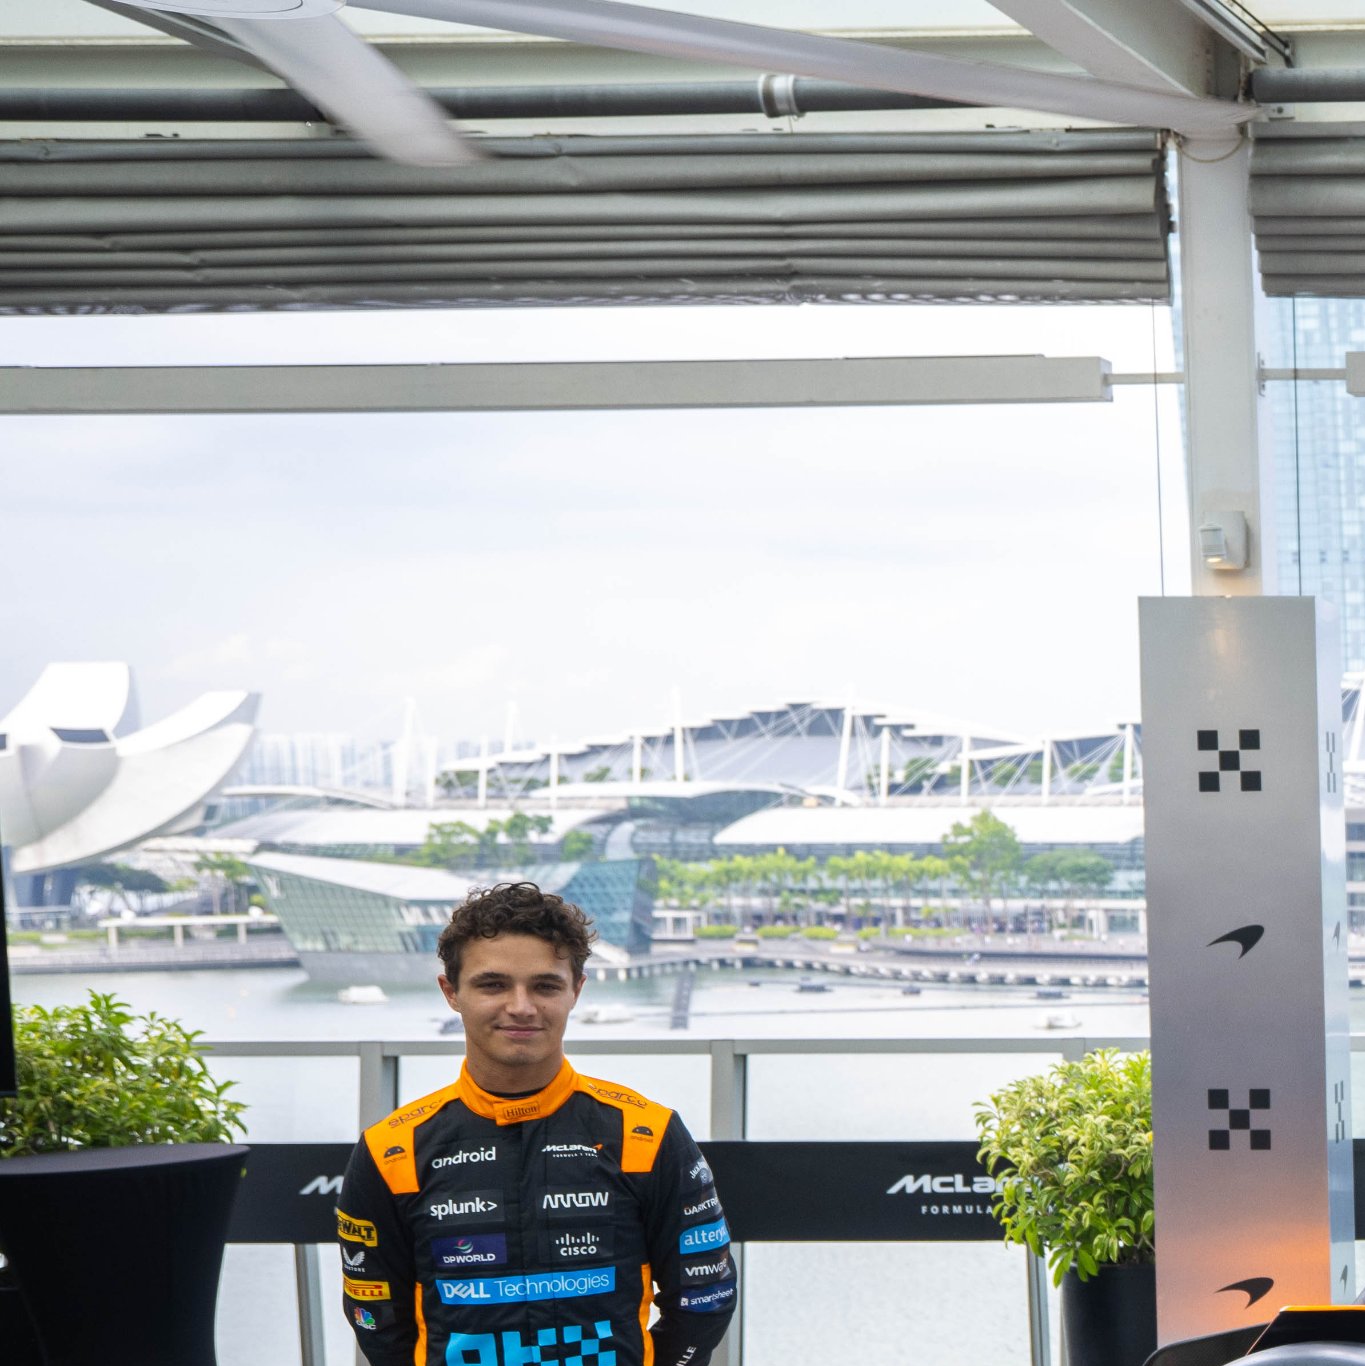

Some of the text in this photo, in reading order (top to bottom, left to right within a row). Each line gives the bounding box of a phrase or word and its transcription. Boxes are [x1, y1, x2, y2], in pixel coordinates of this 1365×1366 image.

[506, 1104, 538, 1119] Hilton
[542, 1144, 597, 1153] McLaren
[432, 1147, 496, 1169] android
[542, 1192, 609, 1210] ARROW
[921, 1205, 993, 1215] FORMULA
[443, 1253, 496, 1264] DP WORLD
[443, 1274, 610, 1299] DELL Technologies
[691, 1288, 734, 1307] smartsheet
